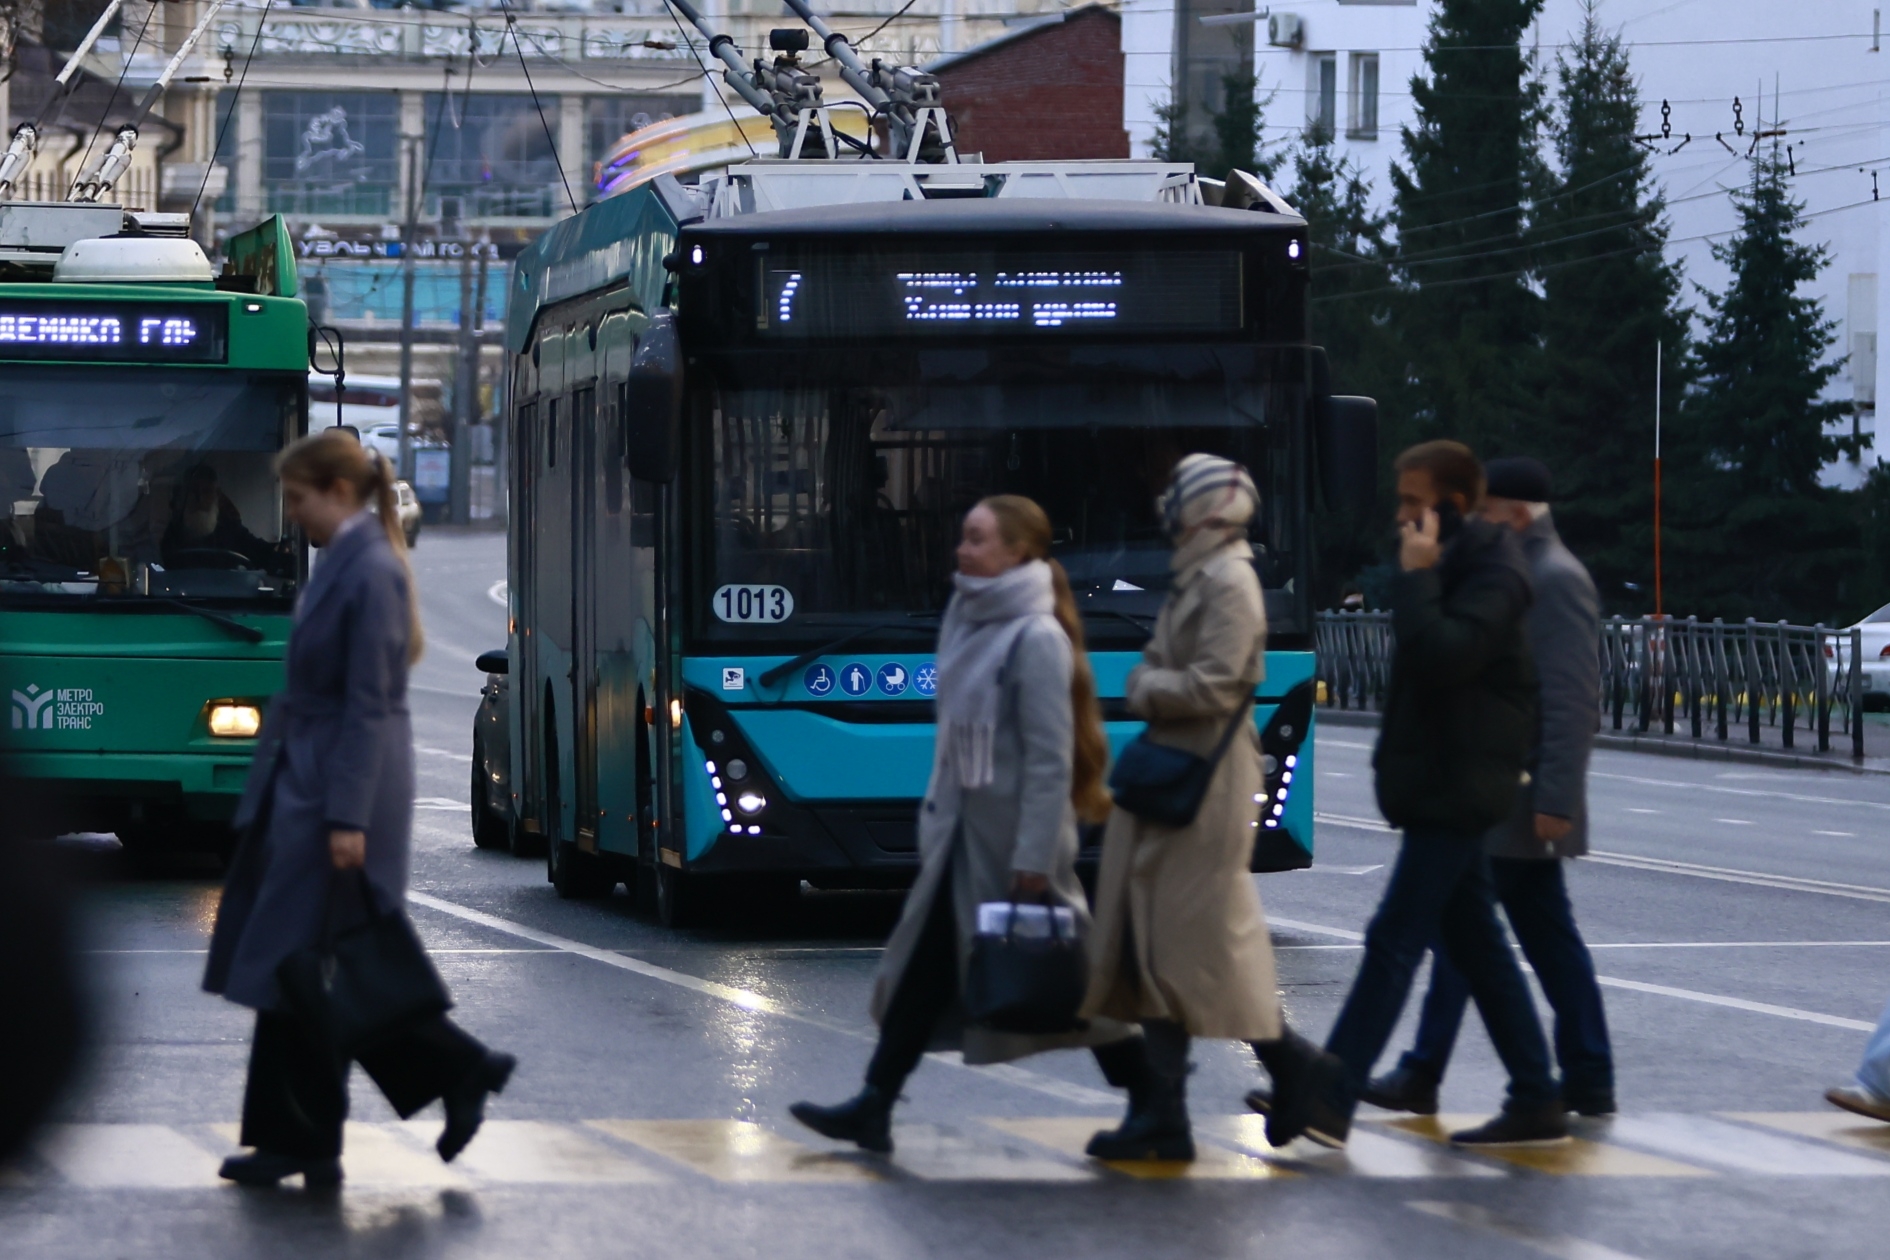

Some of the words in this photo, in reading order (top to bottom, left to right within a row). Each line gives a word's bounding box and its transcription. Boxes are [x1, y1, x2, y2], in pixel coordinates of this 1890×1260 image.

[771, 269, 802, 321] 7
[720, 587, 785, 620] 1013
[57, 688, 93, 702] МЕТРО
[57, 702, 104, 716] ЭЛЕКТРО
[57, 716, 92, 730] ТРАНС
